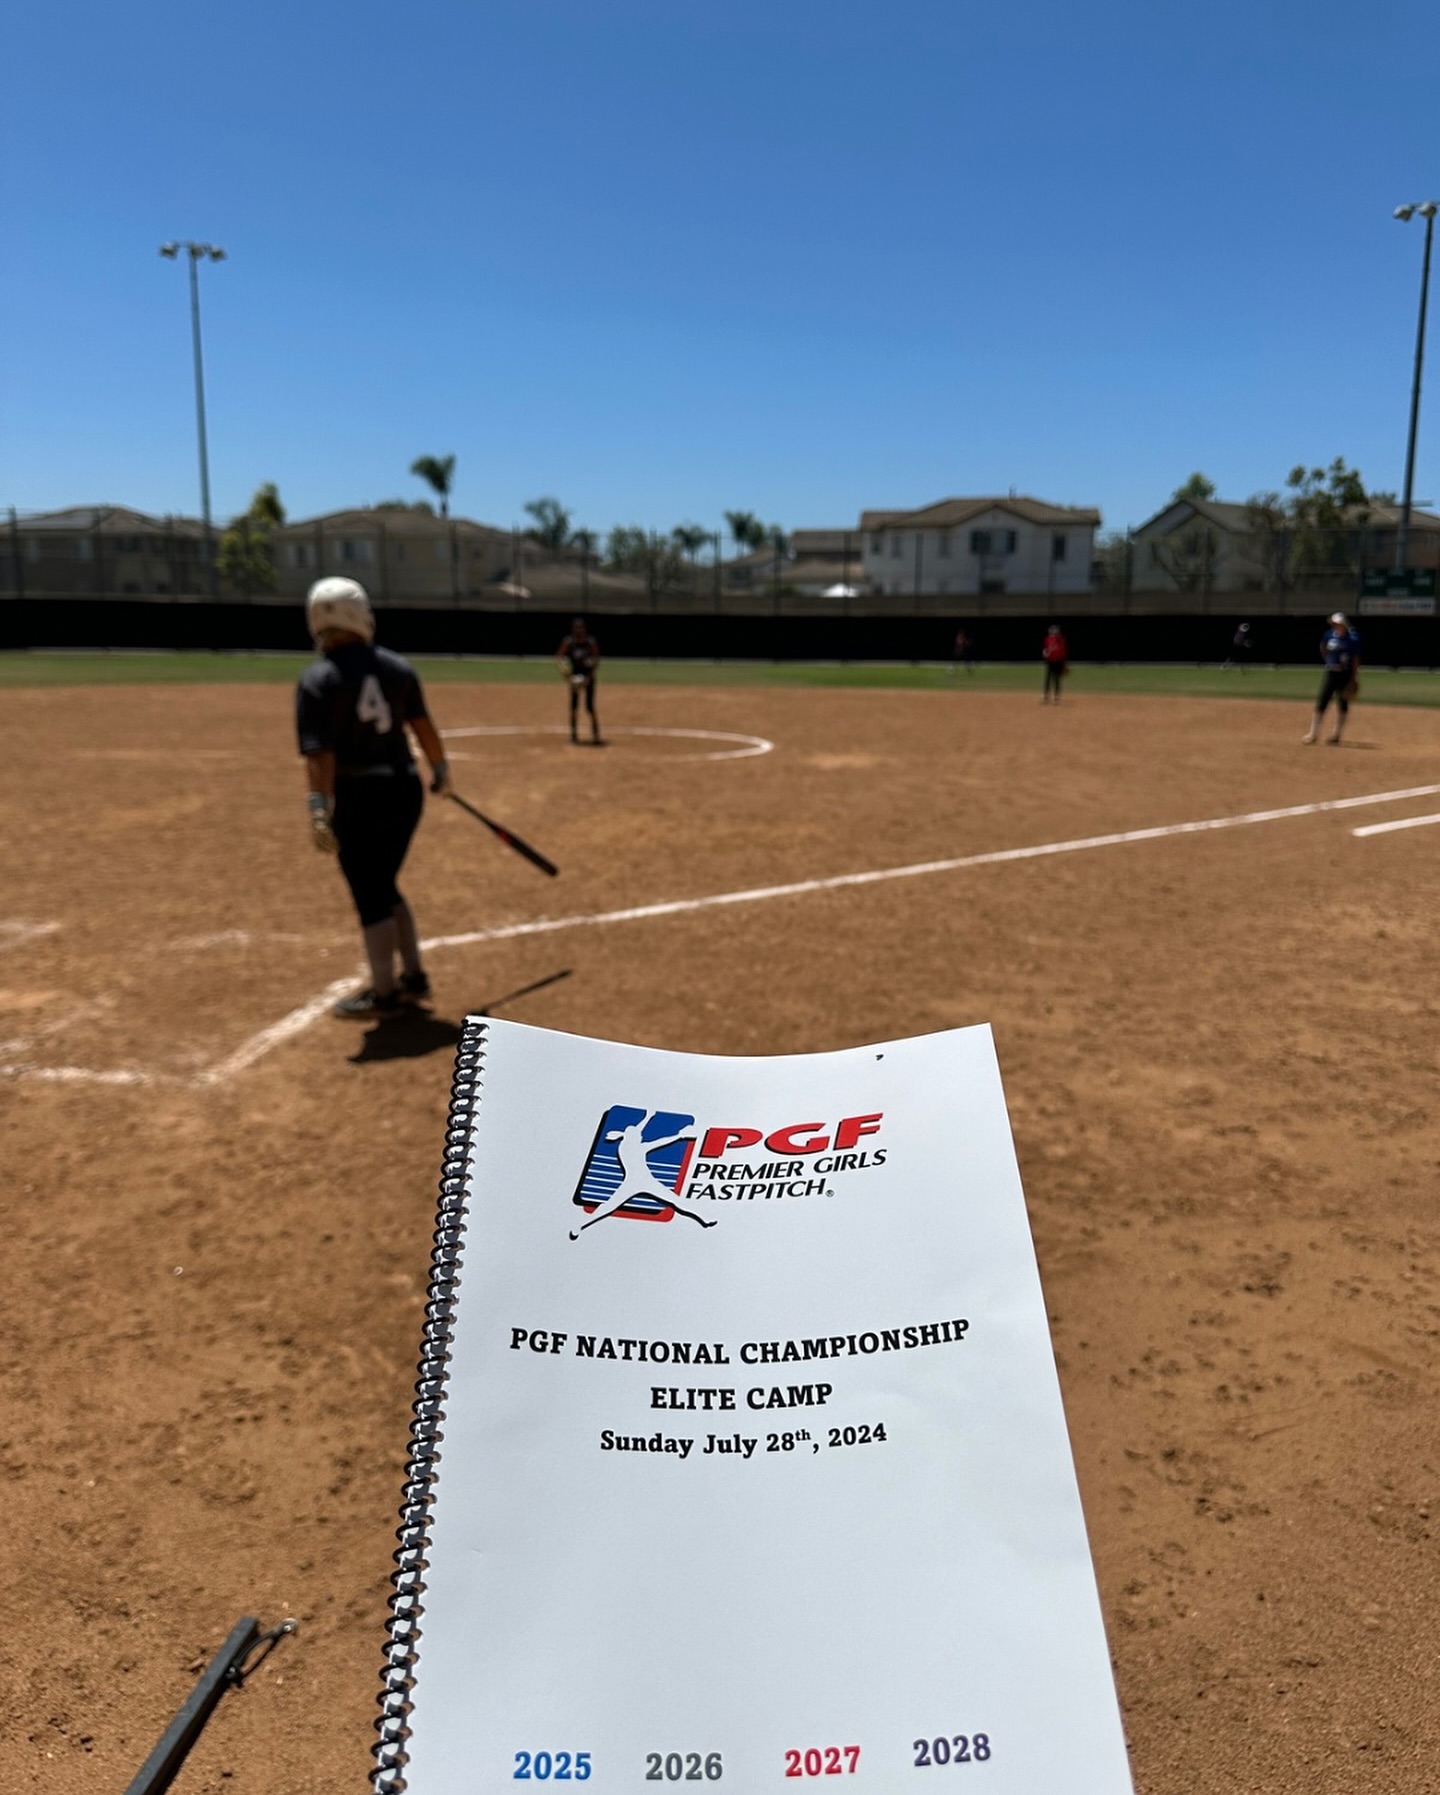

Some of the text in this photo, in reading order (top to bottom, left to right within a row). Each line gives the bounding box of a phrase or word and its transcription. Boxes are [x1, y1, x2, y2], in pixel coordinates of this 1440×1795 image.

[356, 674, 393, 734] 4
[698, 1112, 884, 1159] PGF
[692, 1149, 887, 1180] PREMIER GIRLS
[509, 1318, 970, 1365] PGF NATIONAL CHAMPIONSHIP
[650, 1382, 833, 1411] ELITE CAMP
[600, 1422, 887, 1459] Sunday July 28th, 2024
[513, 1733, 991, 1781] 2025 2026 2027 2028
